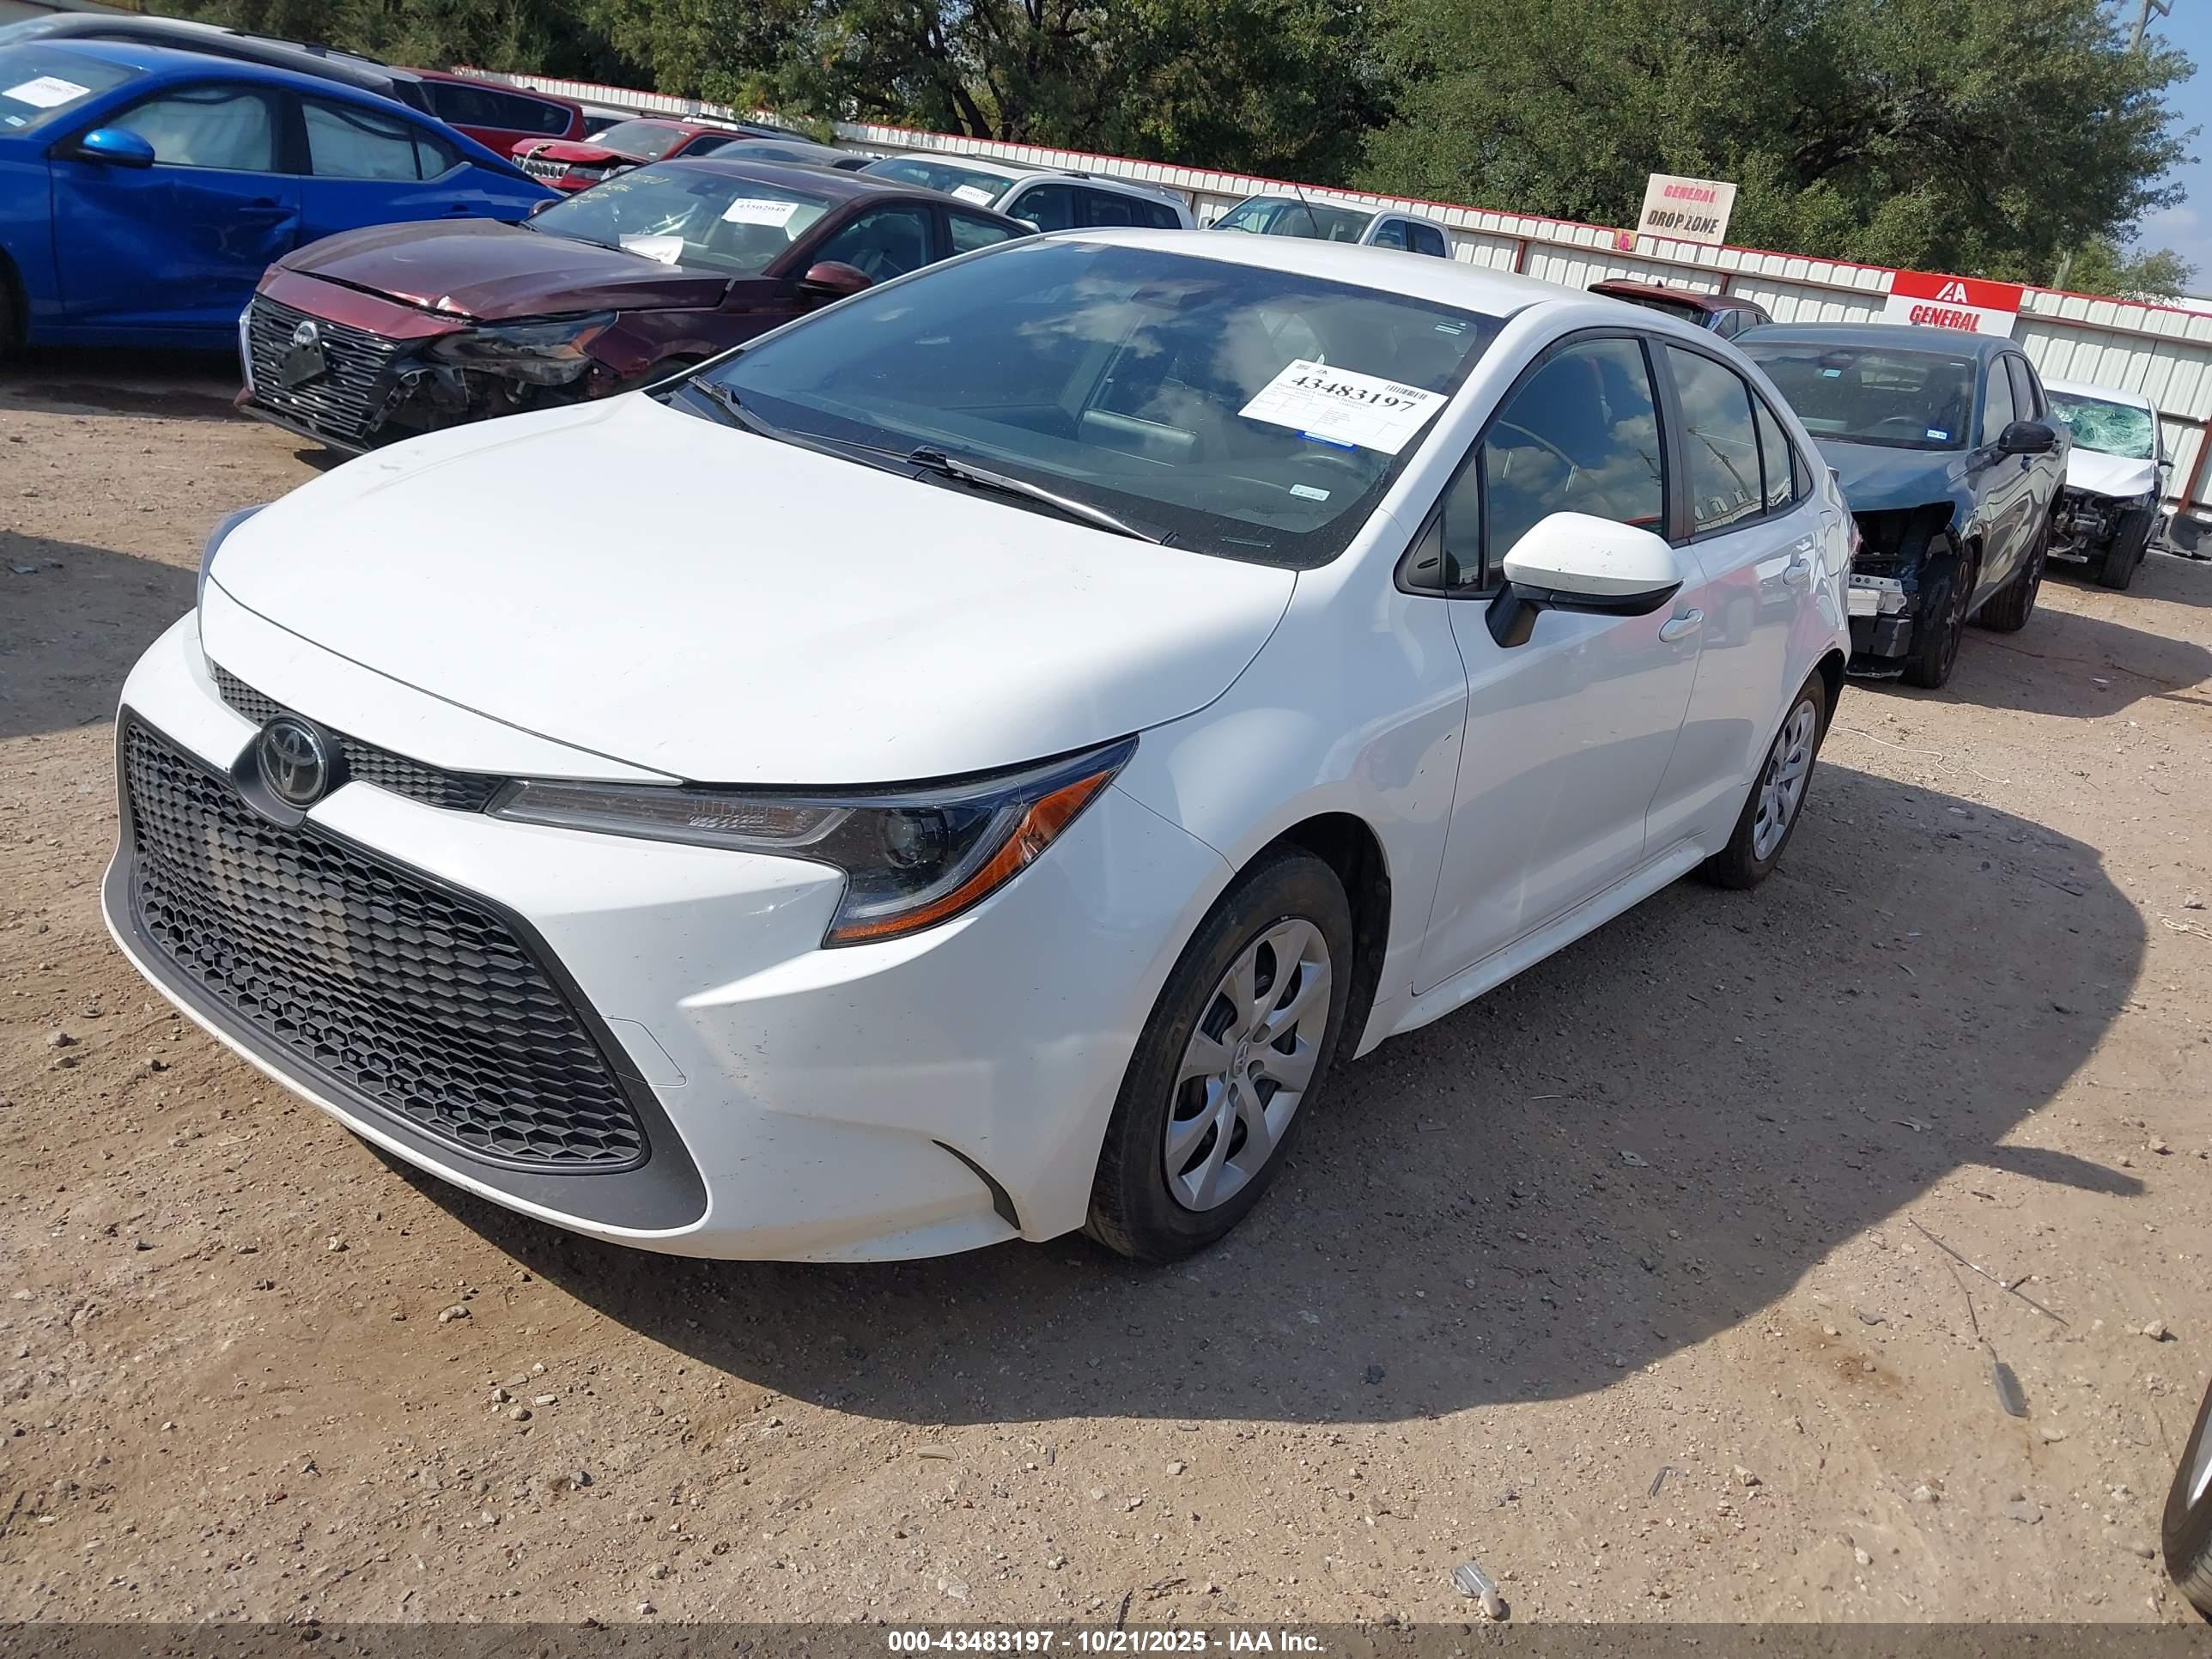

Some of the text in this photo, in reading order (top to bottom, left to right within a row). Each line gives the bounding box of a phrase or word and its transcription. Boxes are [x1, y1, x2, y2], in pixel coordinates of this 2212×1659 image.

[1663, 185, 1717, 204] GENERAL
[1647, 210, 1684, 228] DROP
[1909, 305, 1981, 332] GENERAL
[1291, 376, 1417, 411] 43483197
